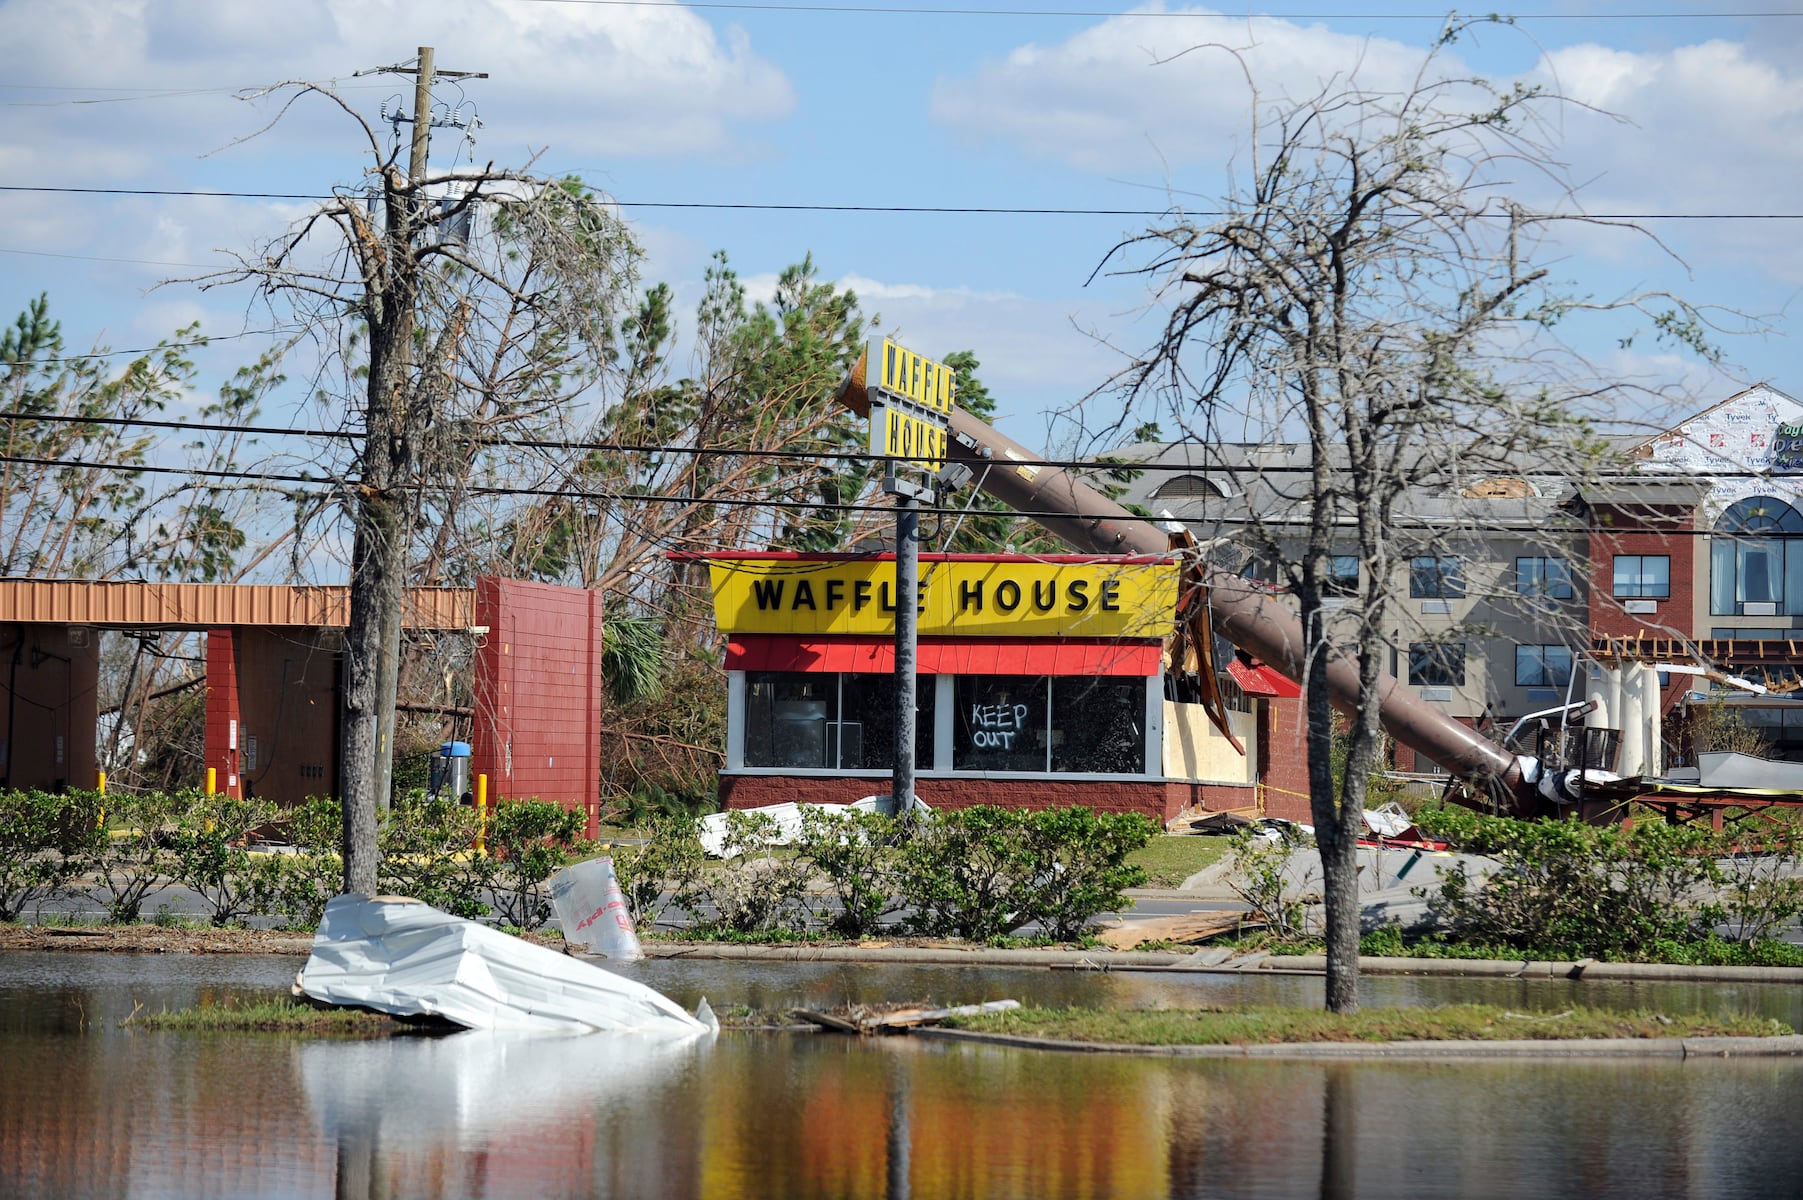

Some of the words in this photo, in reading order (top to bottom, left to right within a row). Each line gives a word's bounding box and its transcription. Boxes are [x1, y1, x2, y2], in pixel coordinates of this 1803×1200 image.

[887, 345, 955, 413] WAFFLE
[890, 413, 947, 468] HOUSE
[962, 579, 1120, 611] HOUSE
[972, 704, 1028, 729] KEEP
[973, 731, 1015, 749] OUT
